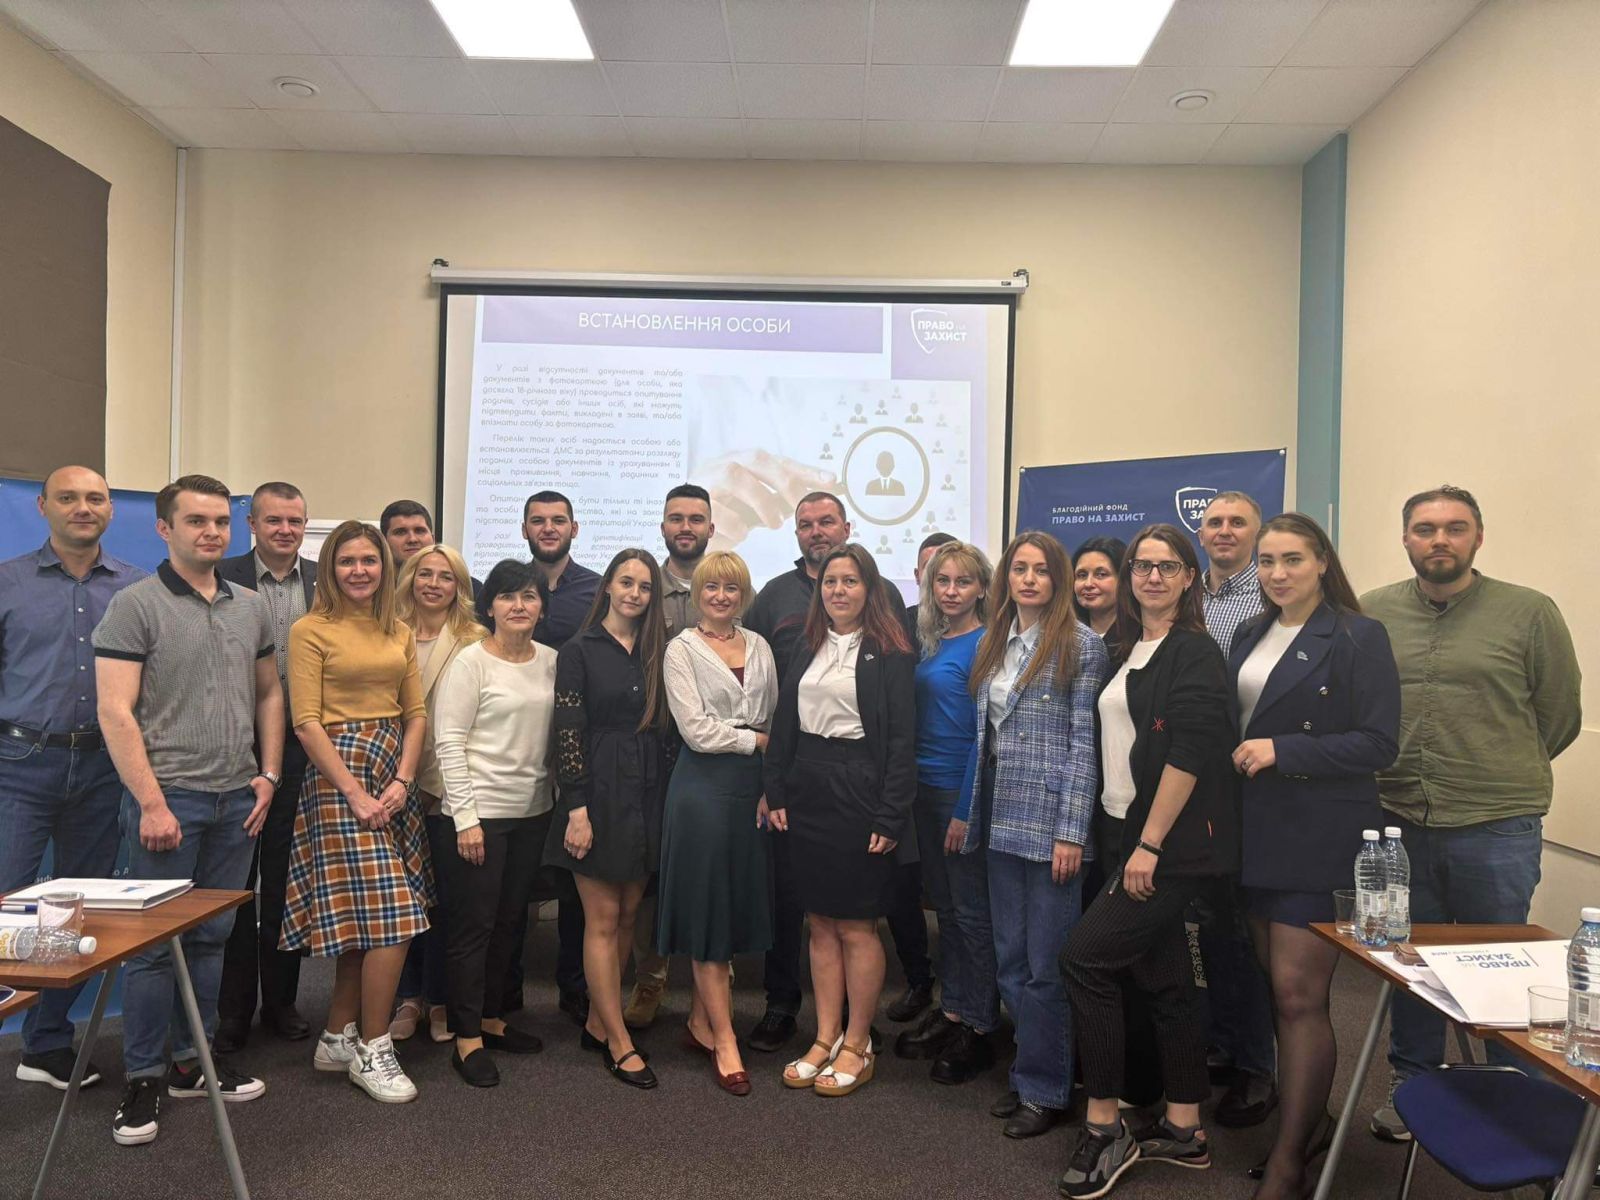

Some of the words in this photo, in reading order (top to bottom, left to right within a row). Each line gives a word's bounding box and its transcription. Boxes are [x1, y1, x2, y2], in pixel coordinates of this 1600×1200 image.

[578, 312, 721, 333] ВСТАНОВЛЕННЯ
[727, 317, 791, 334] ОСОБИ
[917, 320, 954, 331] ПРАВО
[923, 331, 968, 342] ЗАХИСТ
[1052, 503, 1104, 513] БЛАГОДІЙНИЙ
[1106, 503, 1129, 512] ФОНД
[1052, 514, 1085, 525] ПРАВО
[1087, 514, 1102, 524] НА
[1104, 512, 1146, 523] ЗАХИСТ
[1455, 953, 1515, 962] ЗАХИСТ
[1478, 960, 1531, 969] ПРАВО
